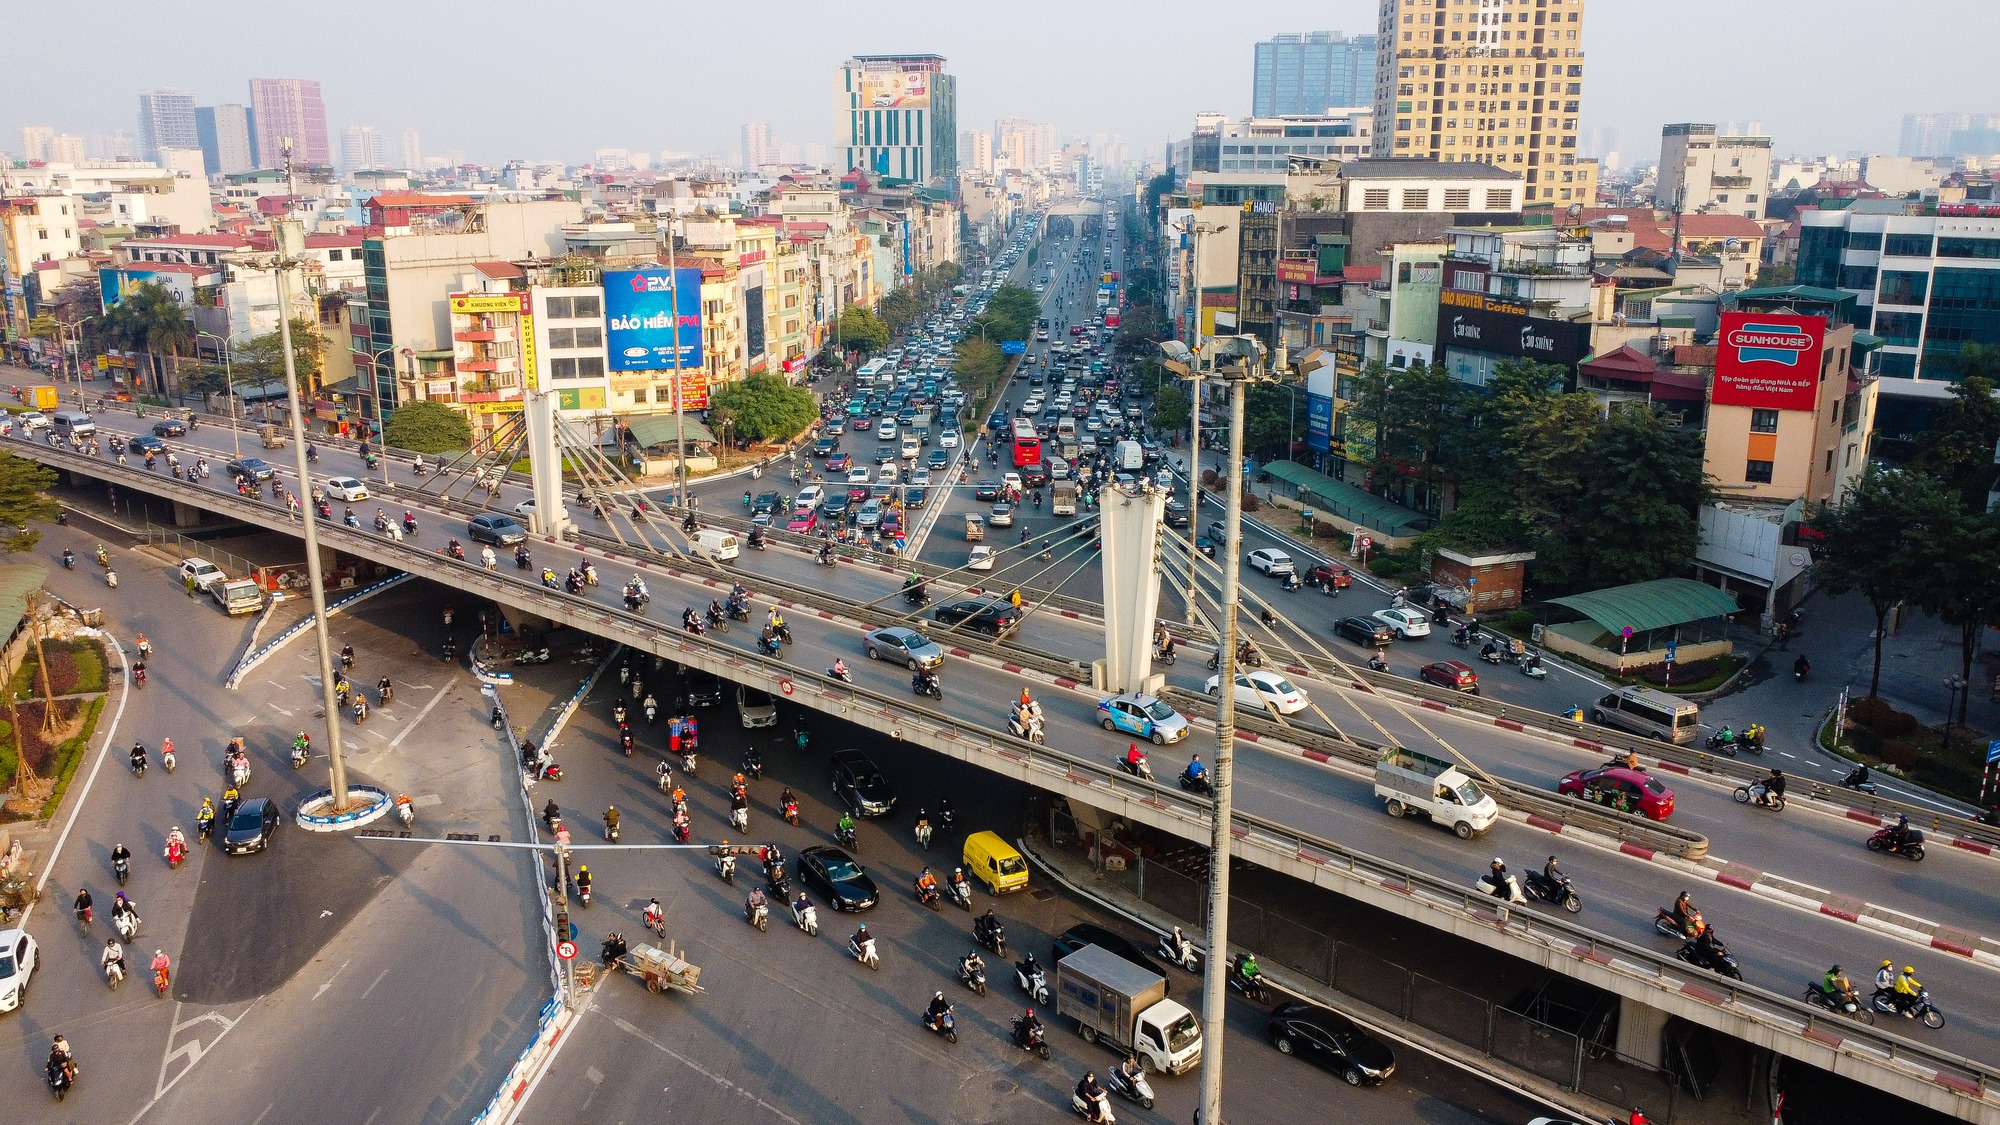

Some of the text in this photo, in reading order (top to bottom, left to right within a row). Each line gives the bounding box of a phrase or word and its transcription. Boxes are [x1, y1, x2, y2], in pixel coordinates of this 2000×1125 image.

[647, 276, 672, 287] PV
[1485, 301, 1526, 316] Coffee
[611, 310, 675, 330] BẢO HIỂM
[678, 315, 699, 327] PVI
[1735, 334, 1806, 347] SUNHOUSE
[1720, 375, 1733, 383] Tập
[1749, 378, 1760, 386] gia
[1760, 378, 1777, 387] dụng
[1735, 383, 1752, 392] hàng
[1765, 385, 1778, 393] Việt
